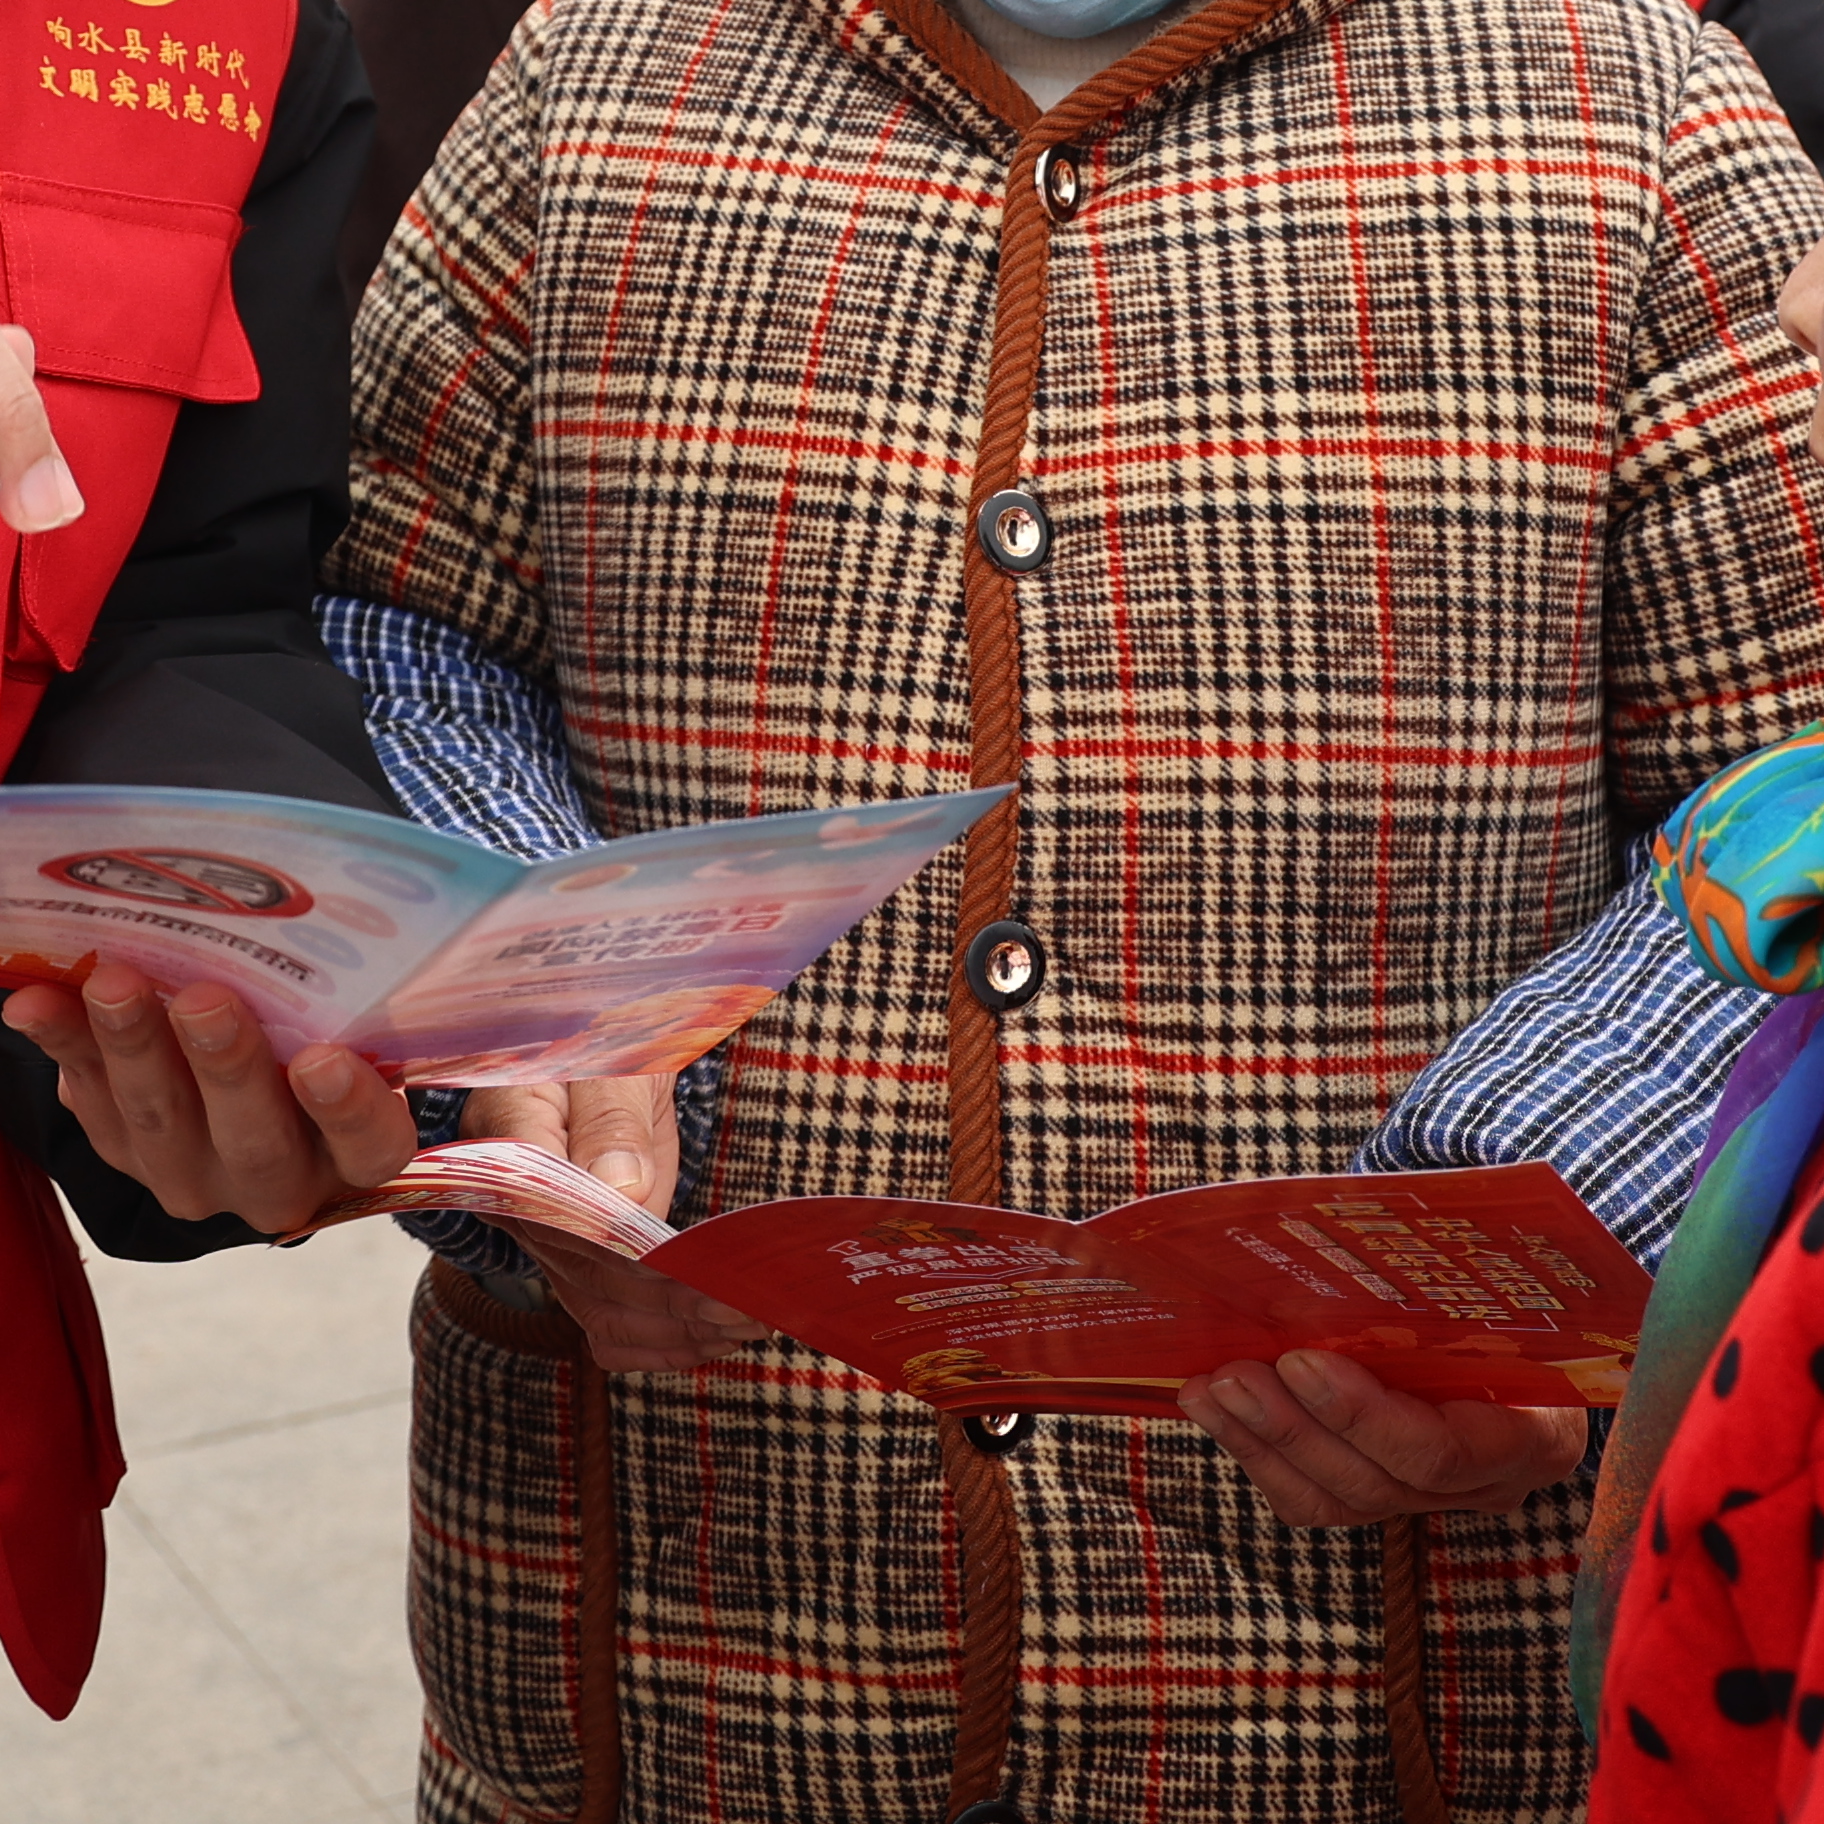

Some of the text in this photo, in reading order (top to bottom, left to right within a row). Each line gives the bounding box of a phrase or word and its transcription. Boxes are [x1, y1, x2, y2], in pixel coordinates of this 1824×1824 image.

[45, 16, 250, 90] 响水县新时代
[39, 55, 262, 142] 文明实践志愿者
[840, 1244, 1062, 1271] 重拳出击
[846, 1256, 1085, 1285] 严惩黑恶犯罪
[1312, 1202, 1514, 1322] 反有组织犯罪法
[1415, 1216, 1567, 1311] 中华人民共和国
